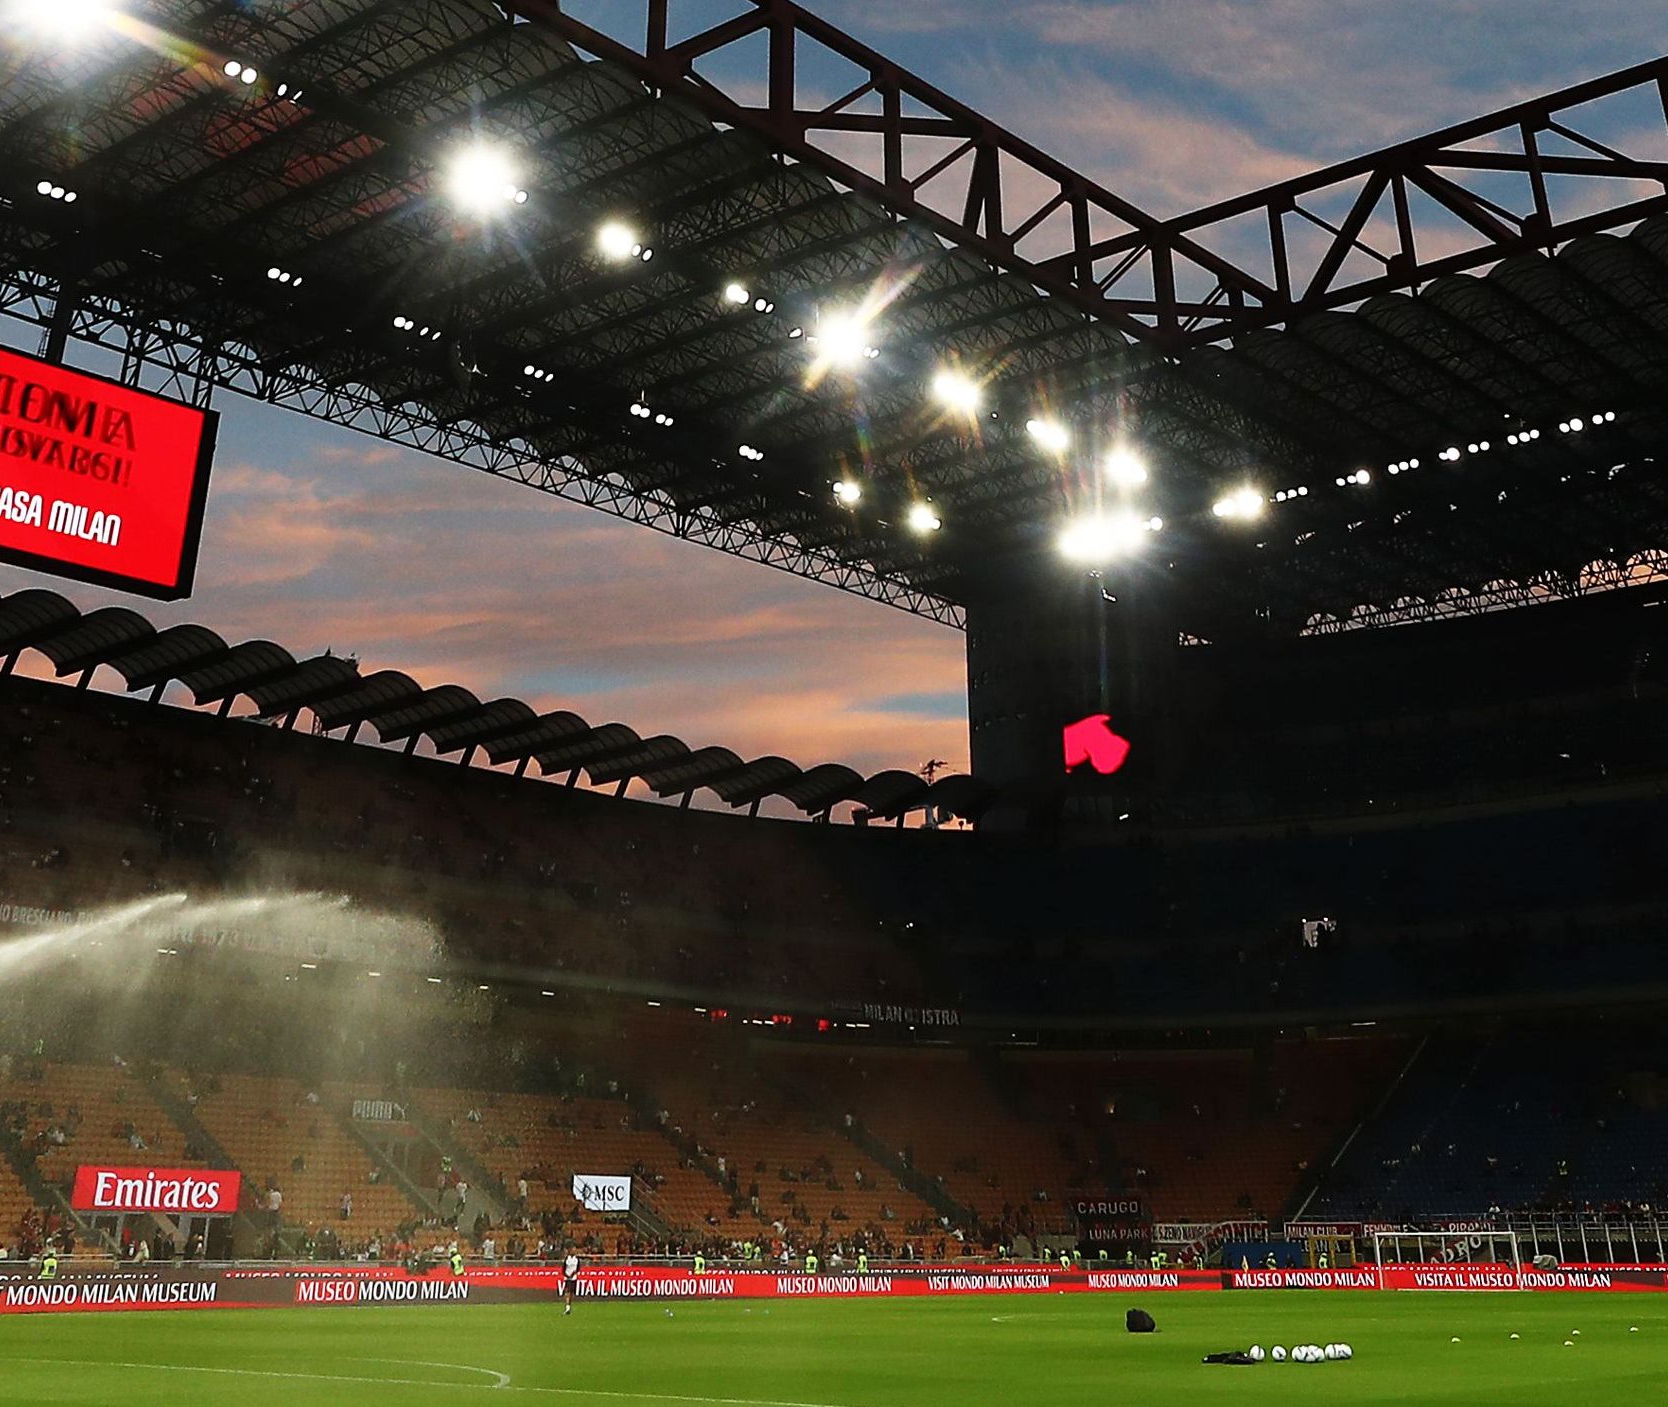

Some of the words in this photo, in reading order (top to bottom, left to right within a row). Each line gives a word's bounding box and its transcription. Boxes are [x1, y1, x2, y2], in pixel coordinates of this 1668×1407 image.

[47, 500, 121, 546] MILAN
[94, 1171, 220, 1209] Emirates
[594, 1185, 625, 1201] MSC
[1077, 1201, 1139, 1214] CARUGO
[1088, 1228, 1118, 1240] LUNA
[1119, 1228, 1149, 1240] PARK
[776, 1276, 815, 1294] MUSEO
[817, 1276, 857, 1293] MONDO
[859, 1276, 892, 1292] MILAN
[926, 1275, 949, 1291] VISIT
[950, 1275, 984, 1290] MONDO
[985, 1275, 1013, 1289] MILAN
[1013, 1275, 1050, 1288] MUSEUM
[1087, 1274, 1117, 1288] MUSEO
[1118, 1274, 1148, 1288] MONDO
[1149, 1274, 1179, 1287] MILAN
[1235, 1272, 1282, 1287] MUSEO
[1285, 1272, 1332, 1287] MONDO
[1334, 1272, 1375, 1287] MILAN
[1414, 1273, 1452, 1287] VISITA
[1455, 1273, 1467, 1287] IL
[1469, 1273, 1513, 1287] MUSEO
[1516, 1273, 1565, 1287] MONDO
[1568, 1273, 1611, 1287] MILAN
[6, 1283, 77, 1306] MONDO
[81, 1283, 140, 1304] MILAN
[141, 1282, 217, 1303] MUSEUM
[298, 1280, 355, 1301] MUSEO
[358, 1280, 417, 1300] MONDO
[421, 1280, 469, 1300] MILAN
[557, 1279, 595, 1297] VITA
[597, 1279, 608, 1296] IL
[610, 1279, 652, 1296] MUSEO
[653, 1279, 697, 1295] MONDO
[698, 1279, 734, 1294] MILAN
